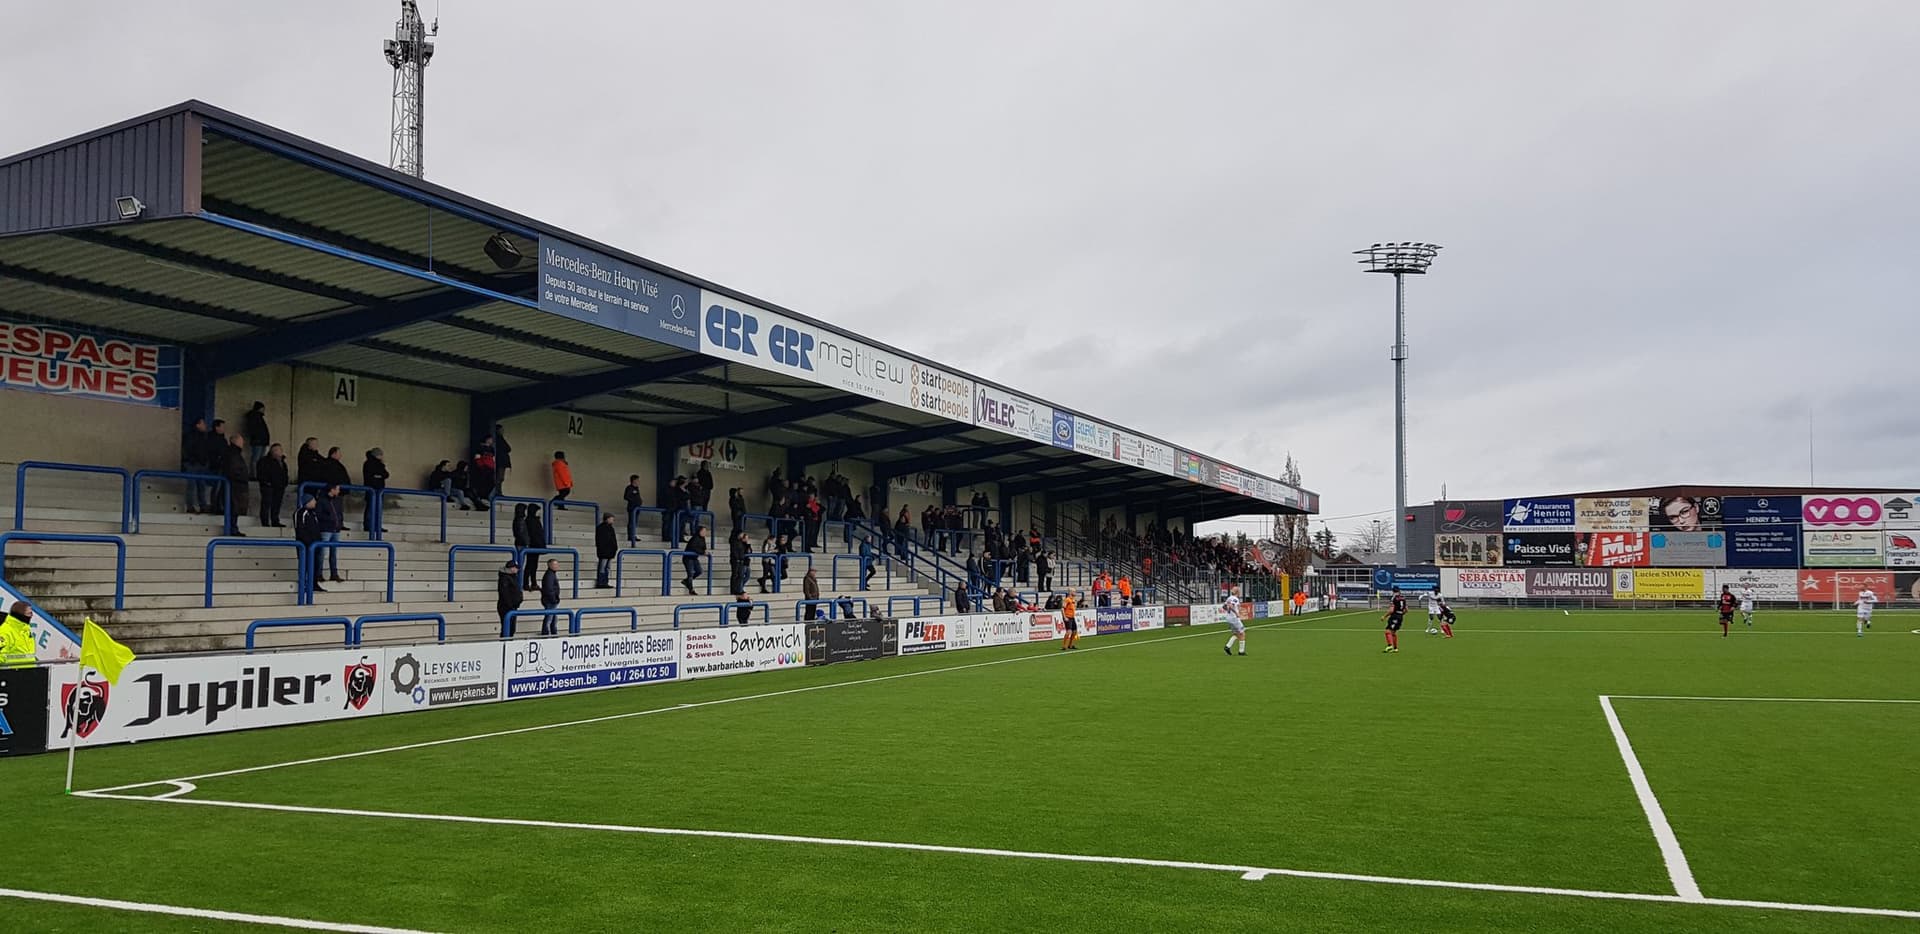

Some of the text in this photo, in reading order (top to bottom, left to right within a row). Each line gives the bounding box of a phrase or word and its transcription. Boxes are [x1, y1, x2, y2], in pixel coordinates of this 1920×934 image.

[546, 247, 659, 298] Mercedes-Benz Henry Visé
[545, 273, 566, 289] Depuis
[567, 280, 576, 292] 50
[576, 284, 587, 294] ans
[588, 287, 597, 298] sur
[598, 290, 603, 301] le
[604, 293, 623, 306] terrain
[631, 301, 649, 314] service
[545, 289, 599, 313] de votre Mercedes
[659, 319, 696, 338] Mercedes-Benz
[705, 304, 815, 372] CBR CBR
[0, 357, 155, 398] EUNES
[336, 378, 355, 402] A1
[568, 415, 583, 436] A2
[1594, 500, 1631, 508] VOYAGES
[1621, 509, 1643, 517] CARS
[1533, 510, 1571, 518] Henrion
[1514, 543, 1571, 554] Paisse Visé
[1459, 573, 1525, 583] SEBASTIAN
[686, 633, 717, 641] Snacks
[730, 626, 801, 655] Barbarich
[562, 635, 674, 663] Pompes Funèbres Besem
[694, 650, 725, 658] Sweets
[424, 660, 482, 675] LEYSKENS
[562, 663, 597, 672] Hermée
[604, 658, 640, 668] Vivegnis
[646, 655, 674, 664] Herstal
[686, 659, 755, 674] www.barbarich.be
[511, 673, 598, 694] www.pf-besem.be
[610, 671, 622, 683] 04
[629, 668, 645, 681] 264
[647, 667, 658, 678] 02
[660, 665, 670, 677] 50
[123, 667, 331, 727] Jupiler
[431, 684, 496, 701] www.leyskens.be
